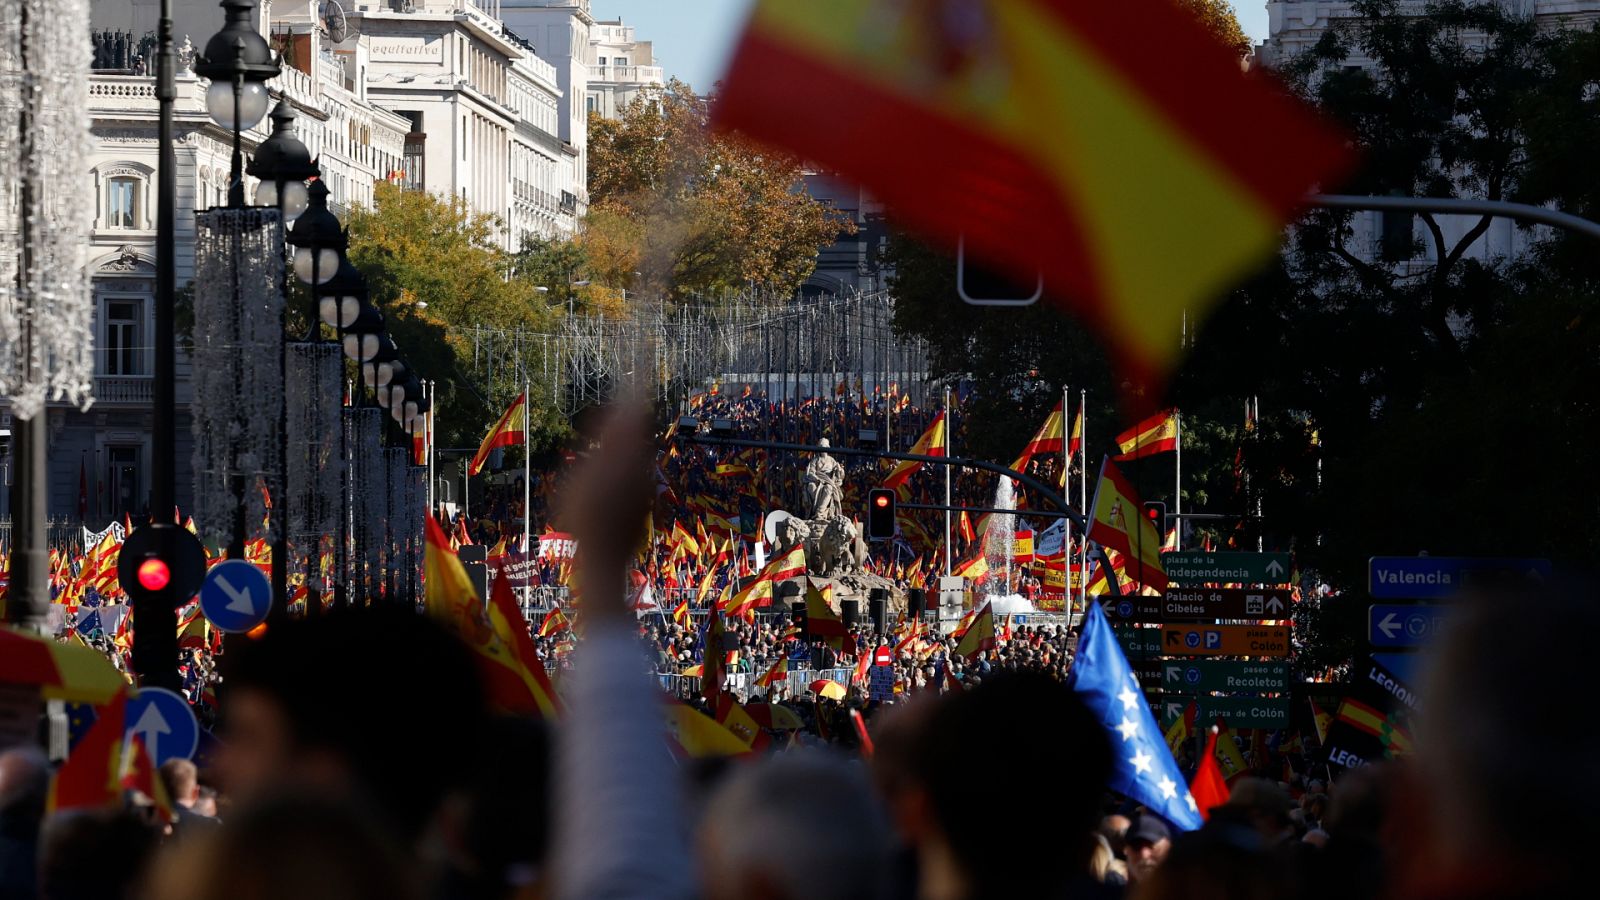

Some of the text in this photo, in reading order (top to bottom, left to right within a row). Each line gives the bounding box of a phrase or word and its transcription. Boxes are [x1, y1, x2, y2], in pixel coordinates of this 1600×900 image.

[372, 44, 438, 55] equitativa
[1166, 556, 1215, 564] plaza de la
[512, 560, 536, 572] golpe
[1166, 567, 1249, 578] Independencia
[1377, 569, 1452, 584] Valencia
[1166, 592, 1222, 602] Palacio de
[1166, 604, 1205, 613] Cibeles
[1246, 629, 1284, 638] plaza de
[1128, 642, 1161, 651] Calos
[1250, 640, 1284, 651] Colón
[1243, 666, 1283, 675] paseo de
[1226, 676, 1284, 687] Recoletos
[1235, 709, 1246, 717] de
[1250, 707, 1285, 718] Colón
